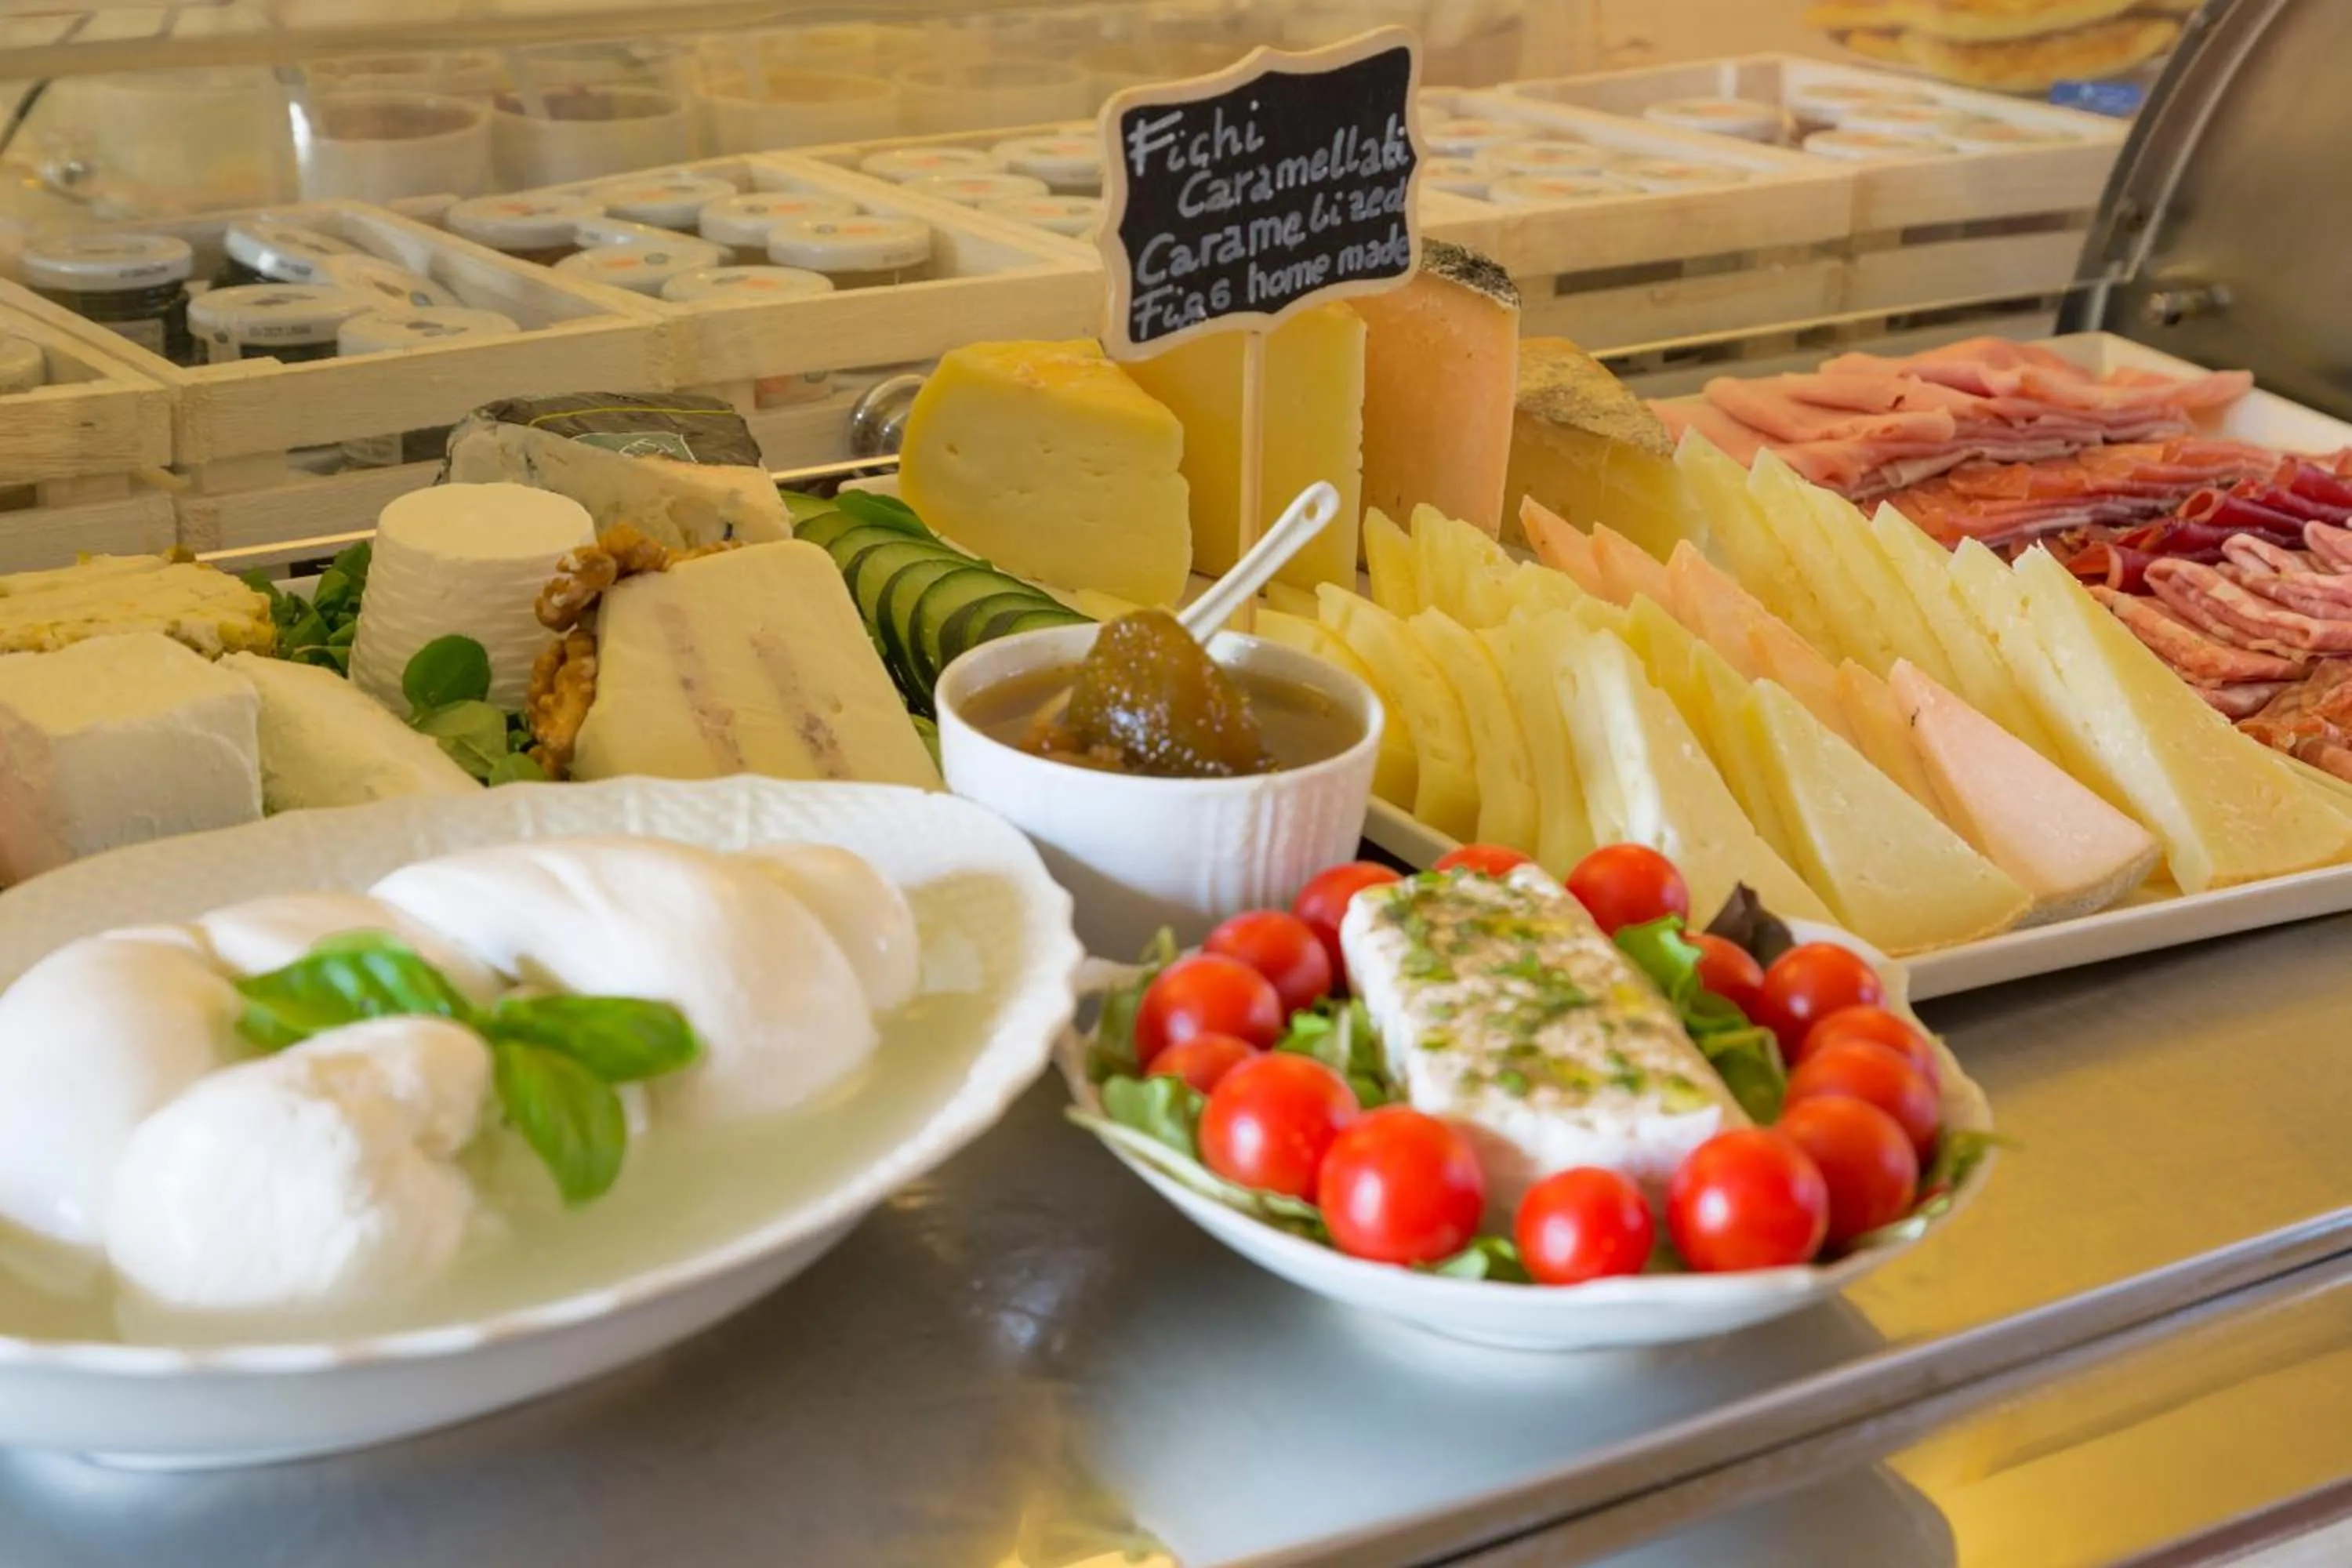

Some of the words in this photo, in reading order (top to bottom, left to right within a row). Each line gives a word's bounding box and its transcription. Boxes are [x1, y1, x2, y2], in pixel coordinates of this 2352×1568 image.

[1127, 100, 1265, 176] Fichi
[1178, 114, 1409, 218] Caramellati
[1248, 252, 1330, 304] home
[1338, 223, 1410, 275] made
